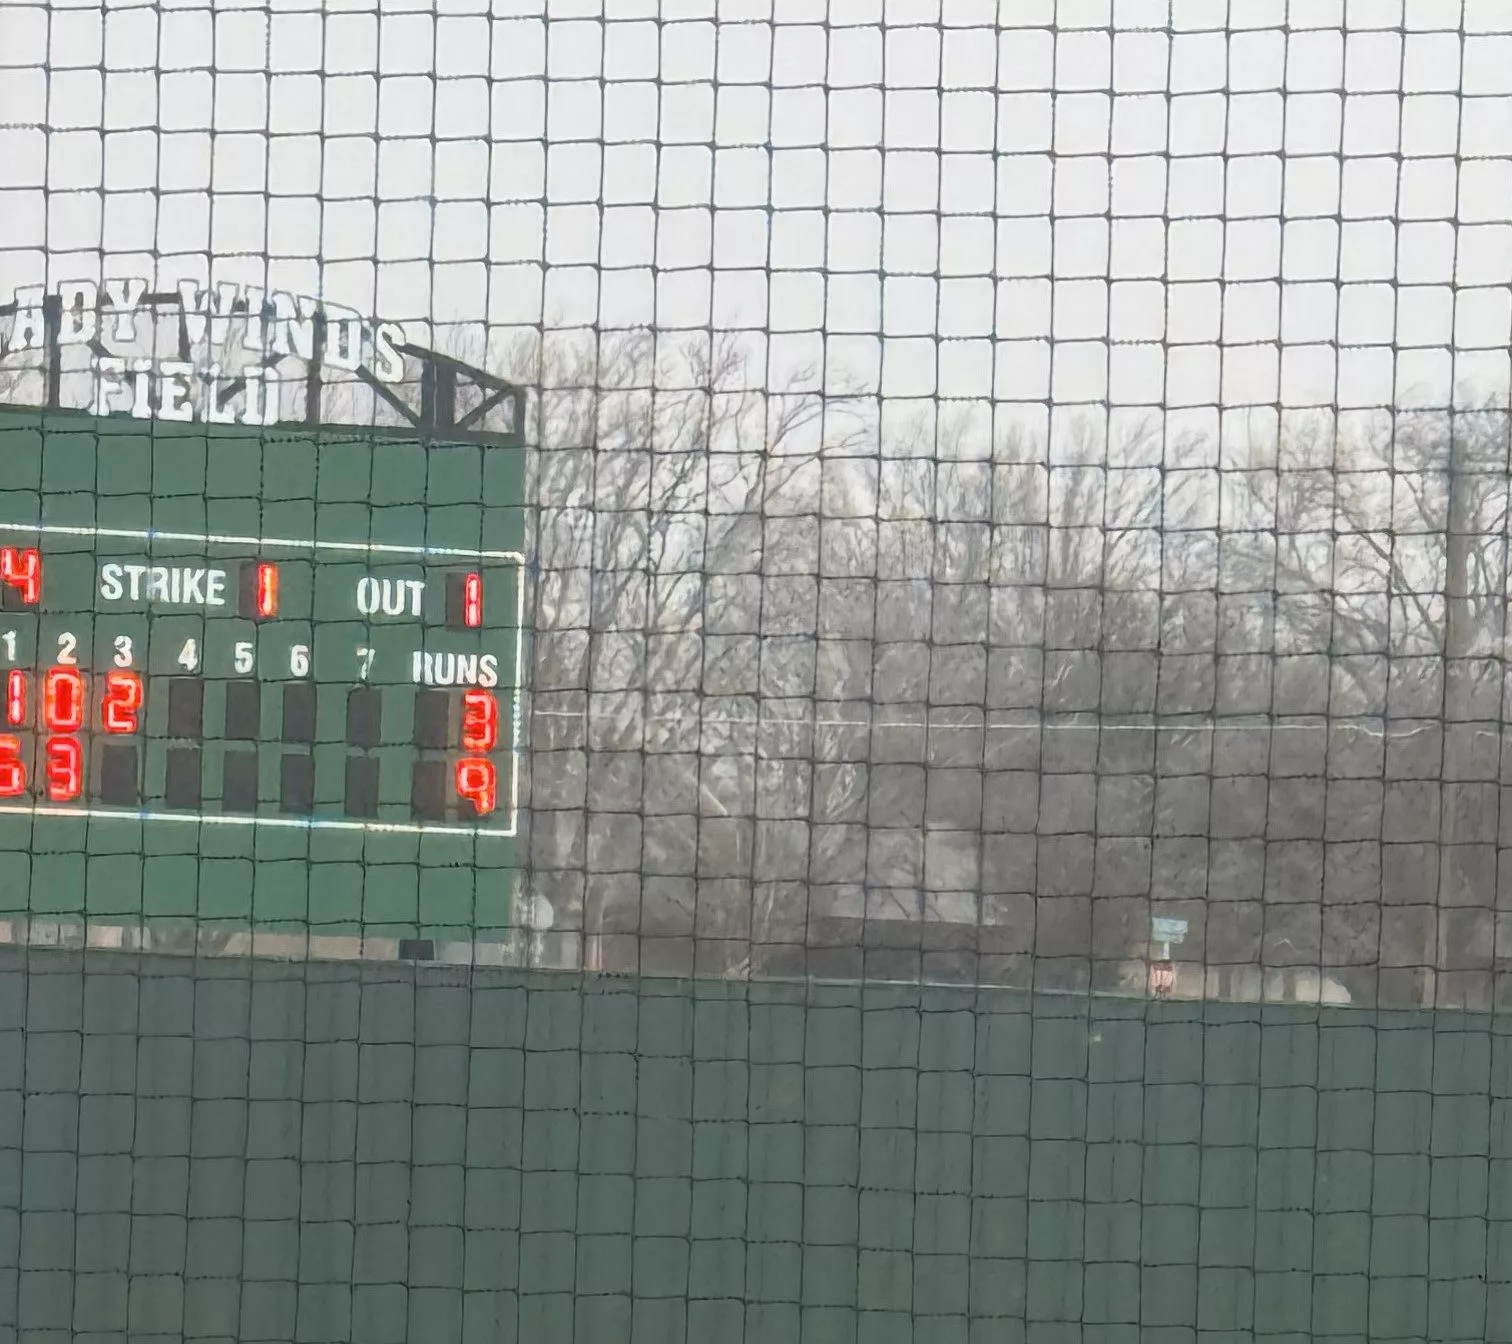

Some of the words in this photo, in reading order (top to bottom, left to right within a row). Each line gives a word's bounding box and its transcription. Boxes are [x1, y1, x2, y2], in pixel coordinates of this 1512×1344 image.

[6, 278, 148, 352] ADY
[177, 279, 406, 383] WINDS
[89, 356, 281, 426] FIELD
[0, 547, 42, 605] 4
[100, 563, 227, 606] STRIKE
[257, 562, 280, 617] 1
[356, 576, 426, 617] OUT
[463, 572, 483, 628] 1
[2, 630, 17, 661] 1
[56, 631, 78, 665] 2
[113, 635, 133, 667] 3
[178, 638, 199, 671] 4
[234, 642, 254, 673] 5
[290, 644, 310, 677] 6
[356, 647, 376, 680] 7
[412, 650, 499, 688] RUNS
[7, 668, 26, 726] 1
[43, 664, 85, 734] 0
[102, 668, 143, 734] 2
[463, 689, 498, 753] 3
[46, 733, 83, 802] 3
[455, 756, 497, 817] 9
